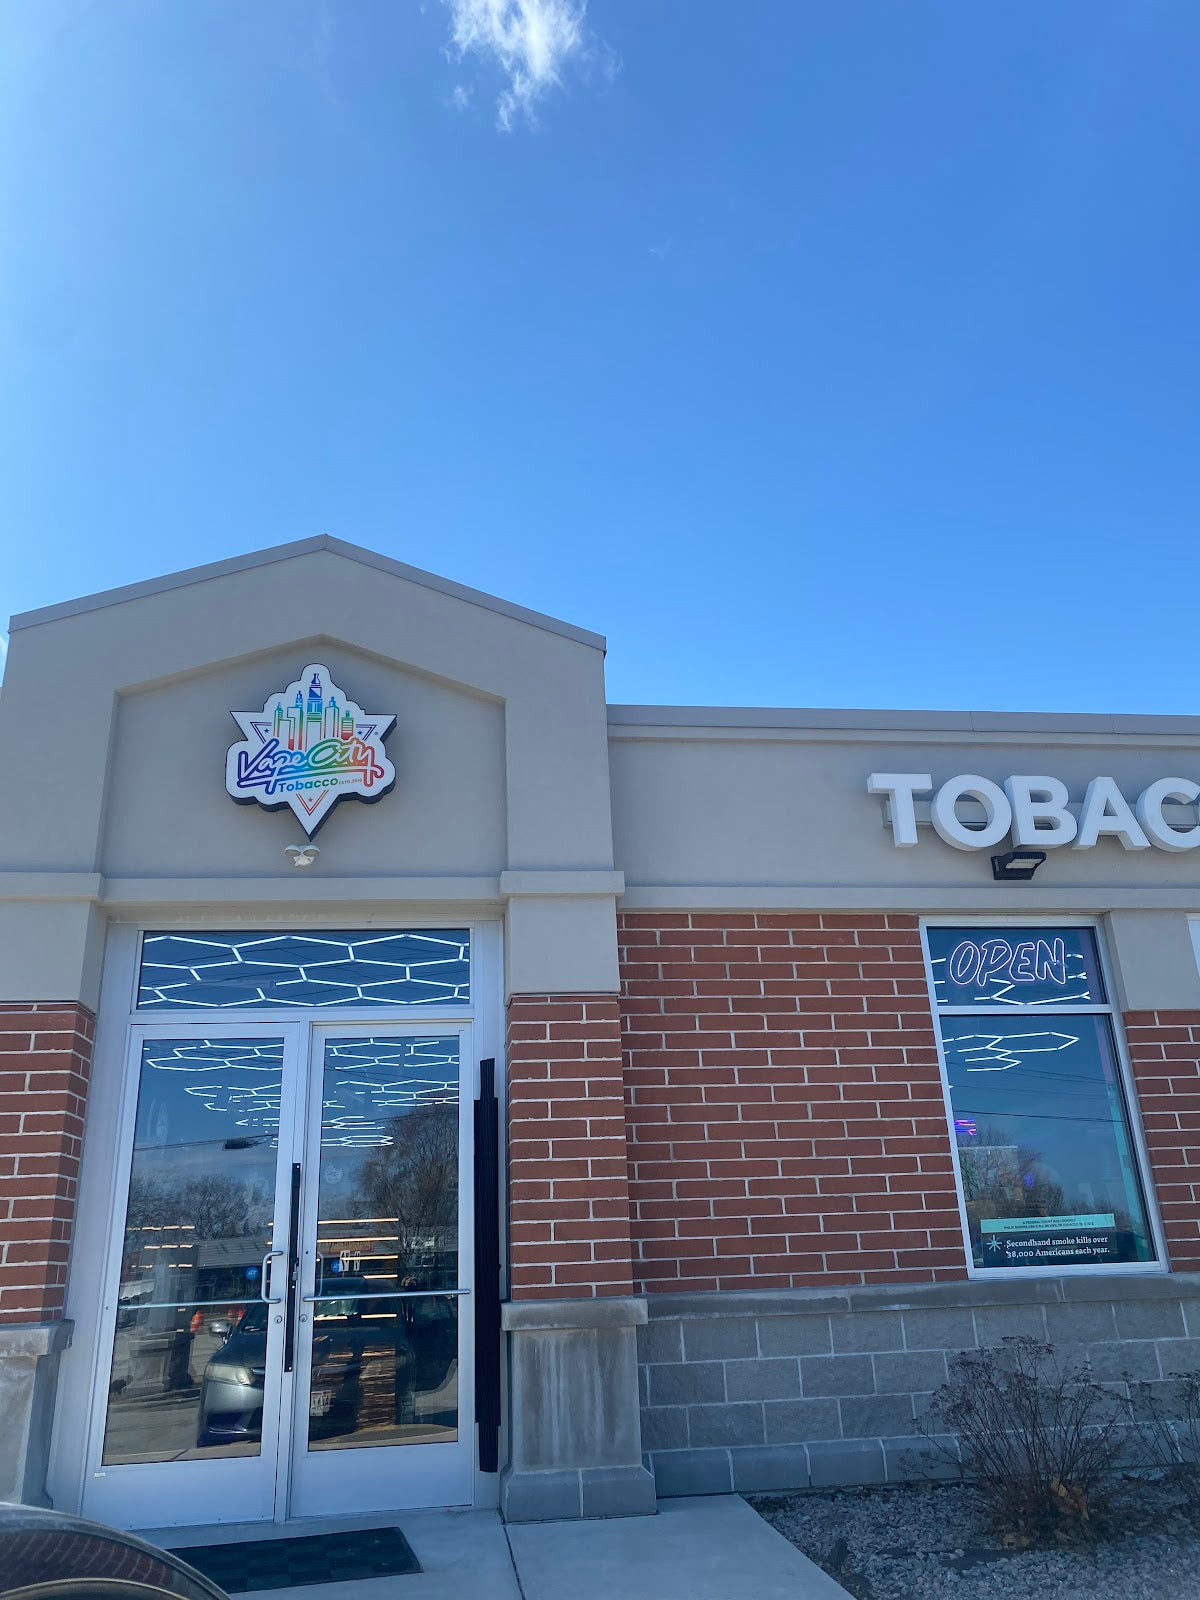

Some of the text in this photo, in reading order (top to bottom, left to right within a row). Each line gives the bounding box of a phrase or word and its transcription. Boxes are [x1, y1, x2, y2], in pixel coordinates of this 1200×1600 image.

[237, 737, 385, 795] Vape City
[278, 777, 339, 792] Tobacco
[867, 772, 1200, 852] TOBAC
[950, 937, 1066, 987] OPEN
[1006, 1238, 1051, 1248] Secondhand
[1052, 1237, 1075, 1245] smoke
[1076, 1236, 1092, 1244] kills
[1035, 1248, 1074, 1257] Americans
[1075, 1247, 1092, 1255] each
[1092, 1247, 1110, 1256] year.
